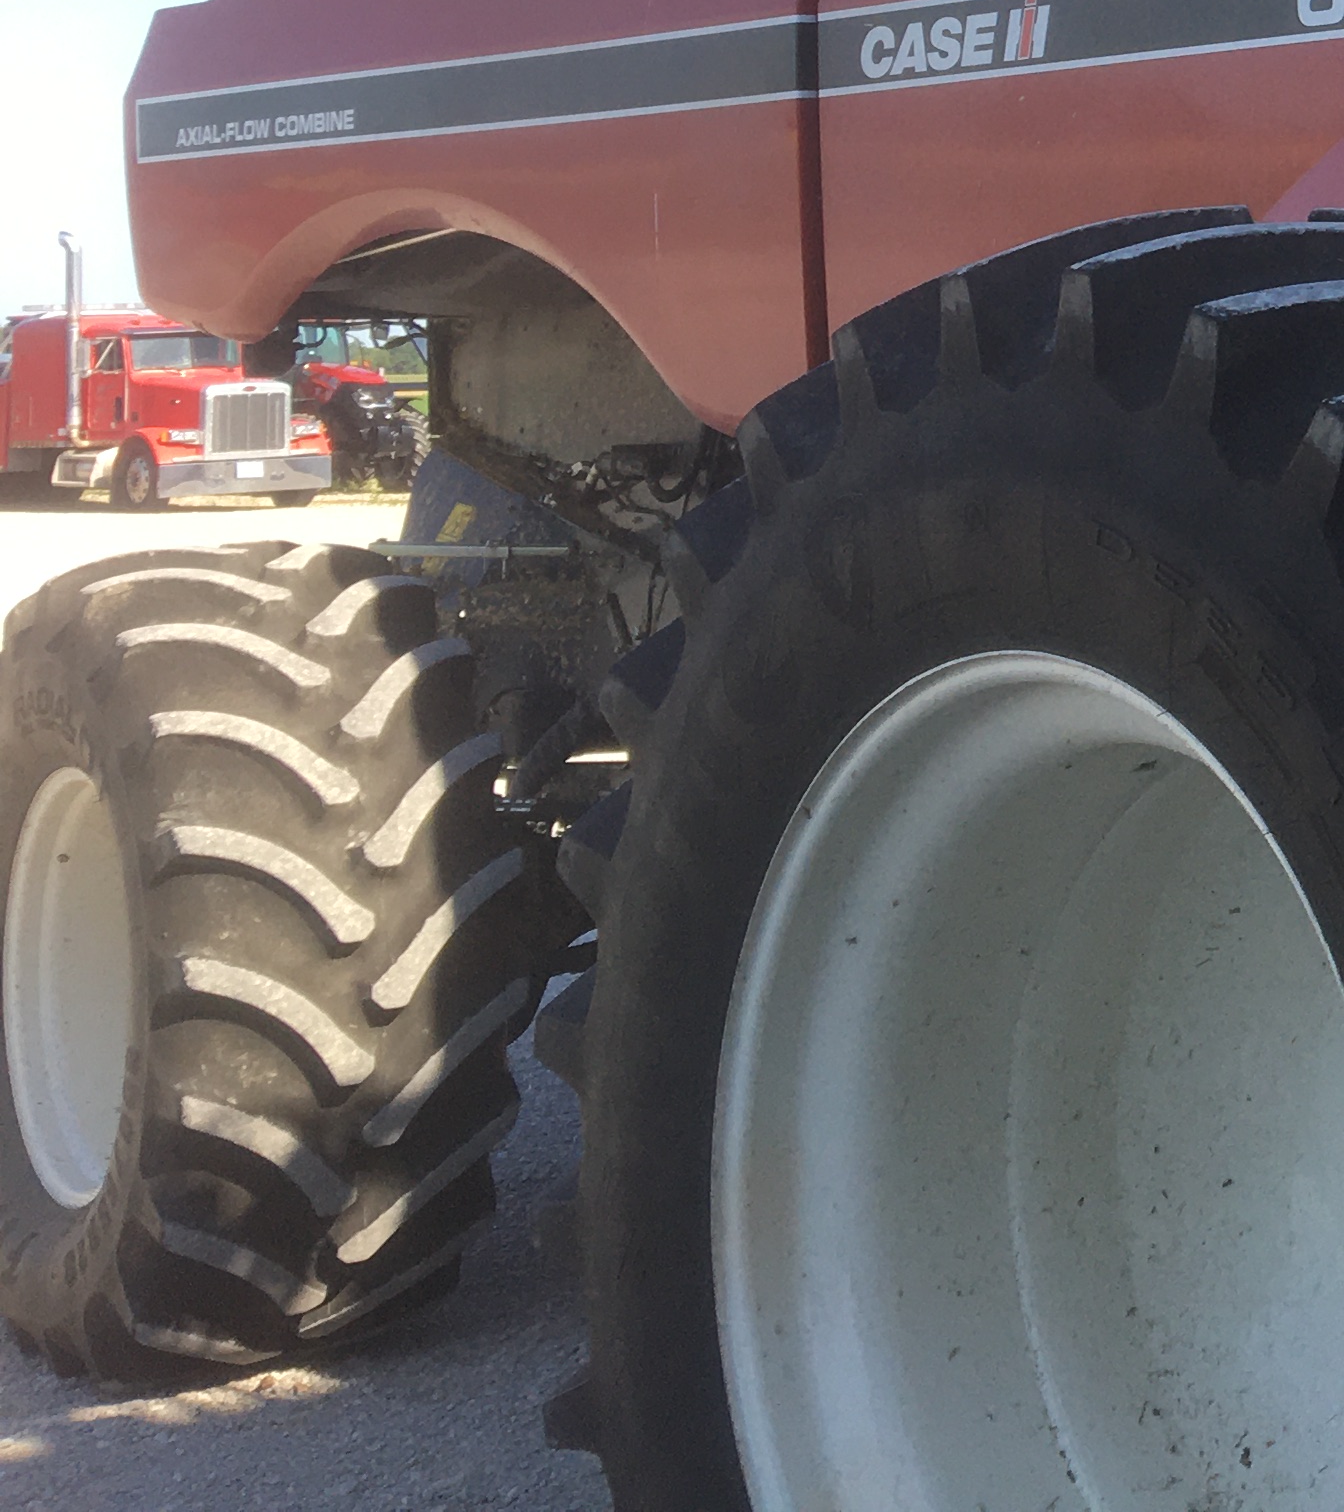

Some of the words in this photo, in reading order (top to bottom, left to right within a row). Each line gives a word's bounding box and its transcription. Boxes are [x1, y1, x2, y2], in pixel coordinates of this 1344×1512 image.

[860, 11, 998, 79] CASE
[175, 118, 270, 148] AXIAL-FLOW
[274, 109, 355, 138] COMBINE
[1090, 516, 1300, 718] DEEP
